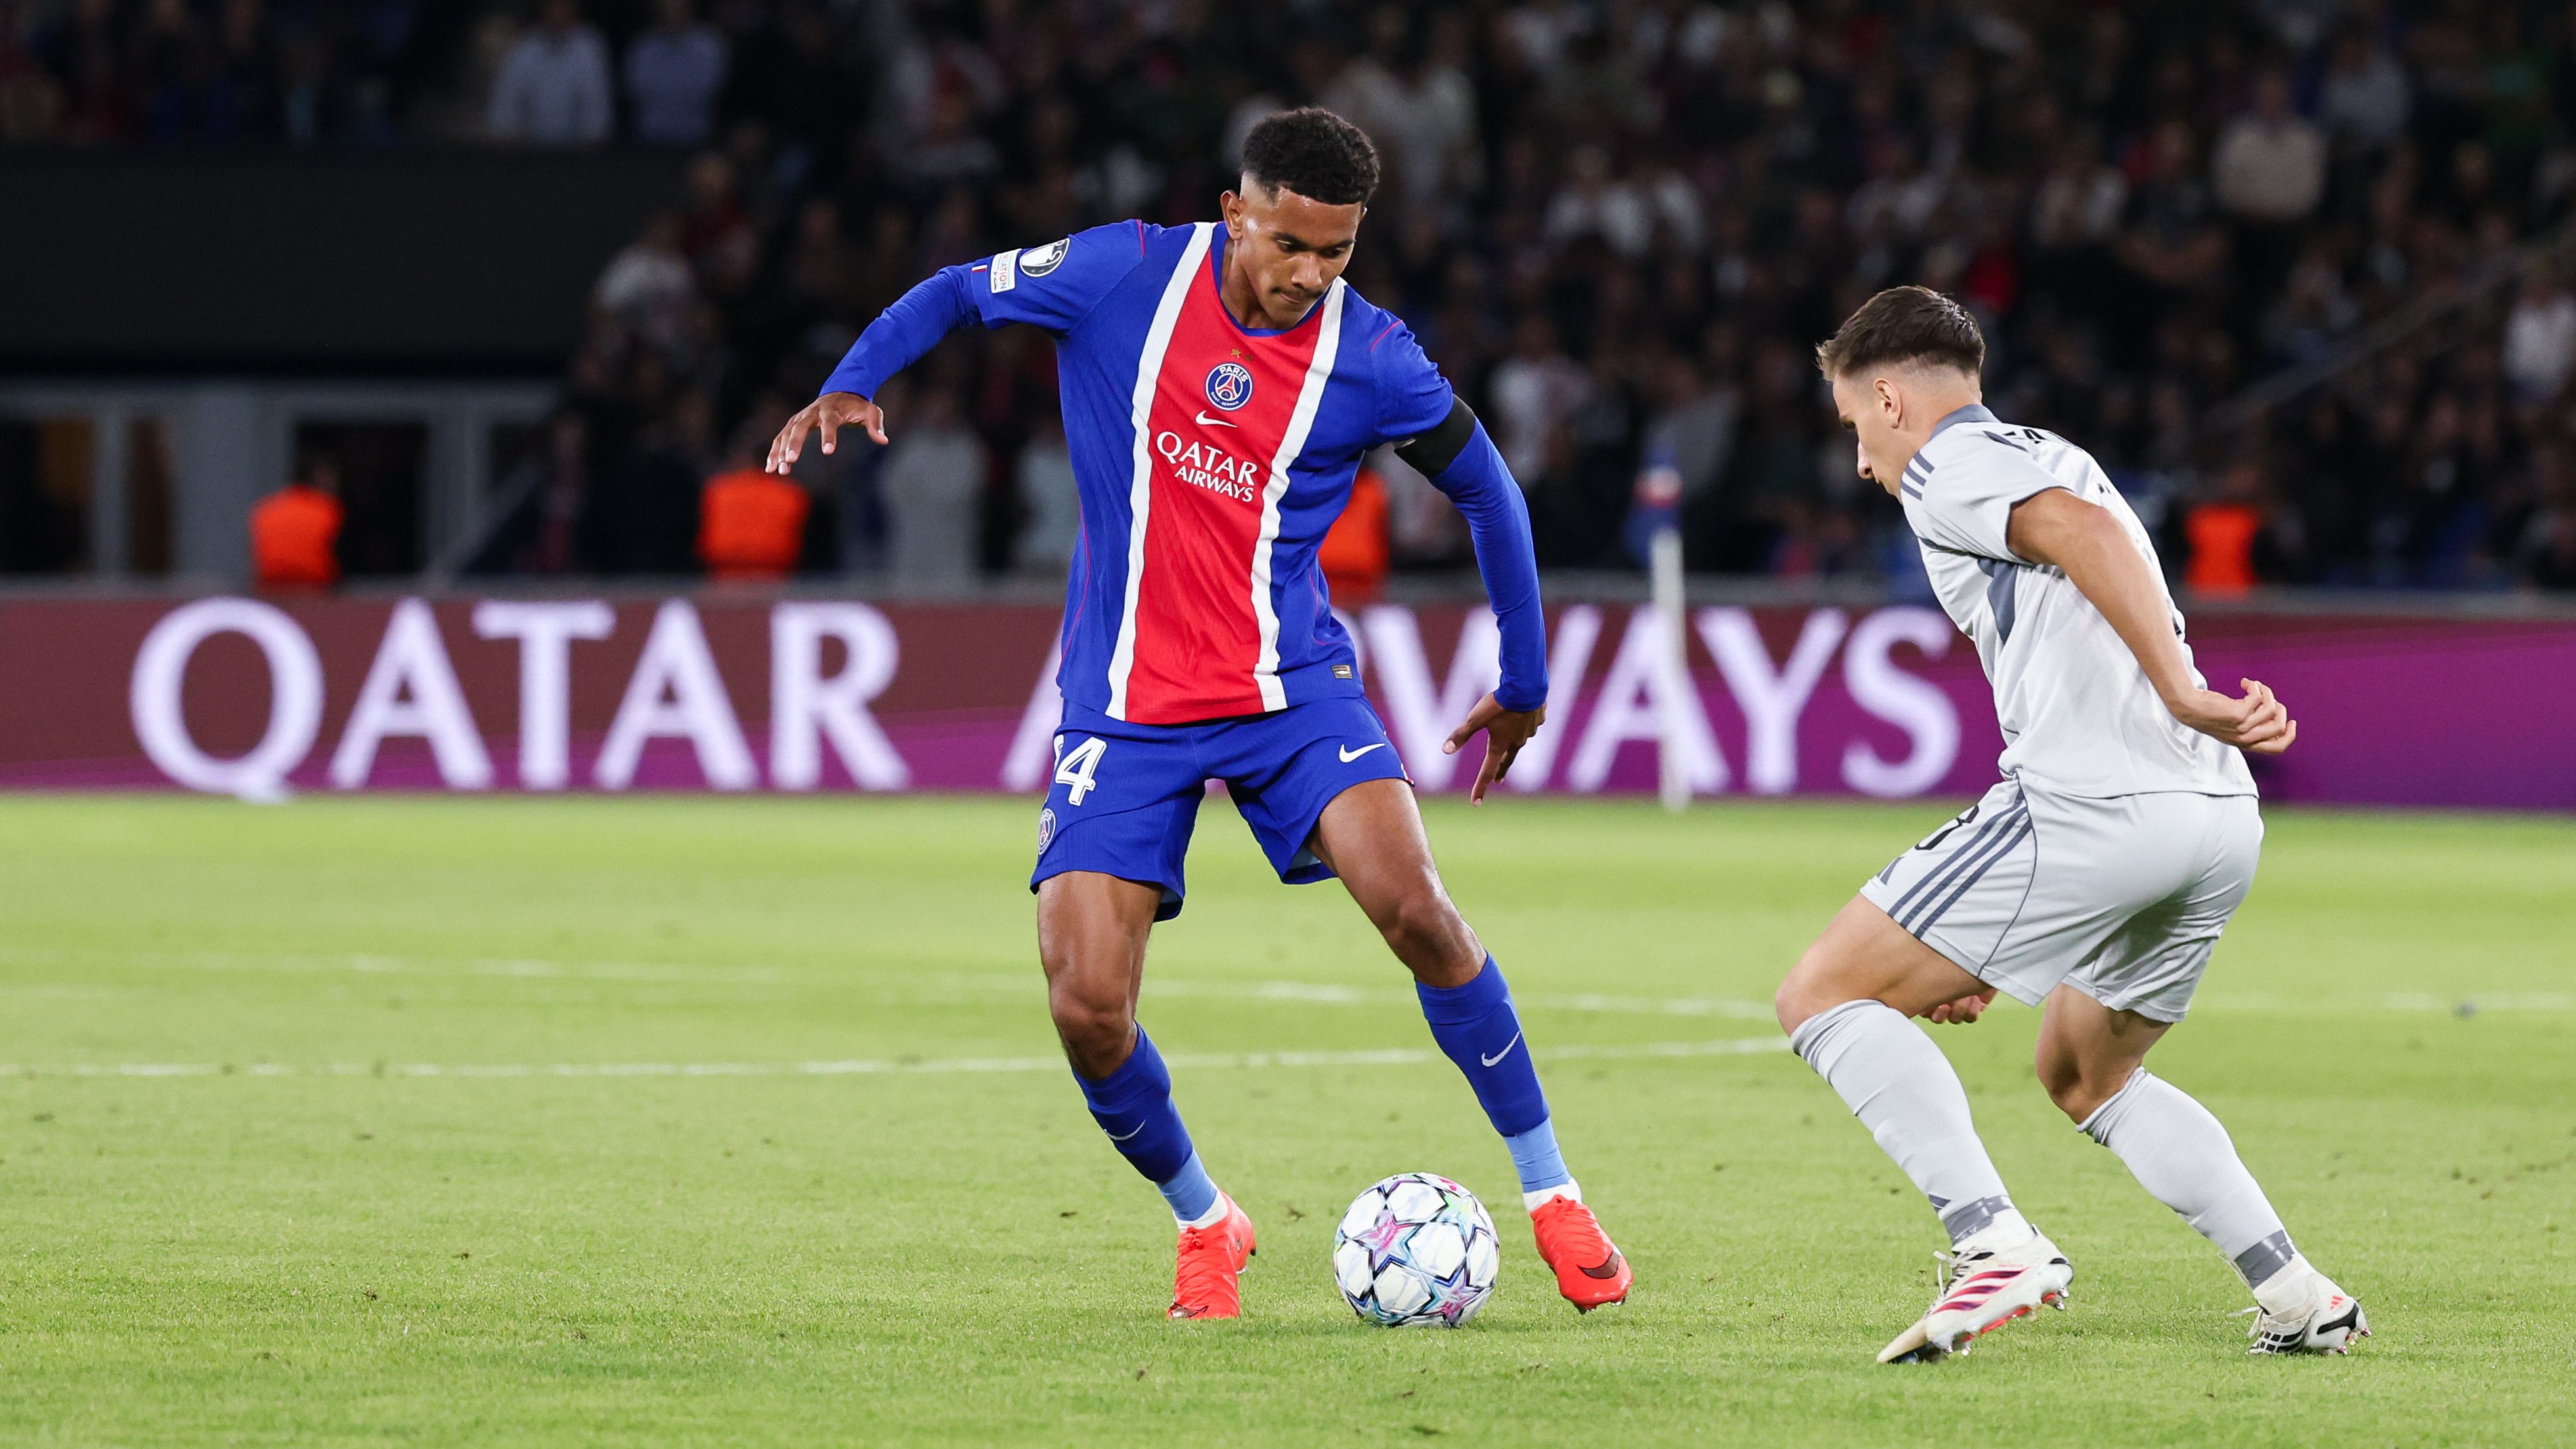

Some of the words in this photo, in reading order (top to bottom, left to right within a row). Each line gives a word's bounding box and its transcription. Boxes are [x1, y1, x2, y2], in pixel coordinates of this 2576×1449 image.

[1219, 366, 1248, 382] PARIS
[1156, 431, 1257, 486] QATAR
[1174, 465, 1254, 502] AIRWAYS
[129, 595, 914, 804] QATAR
[998, 603, 1963, 798] WAYS
